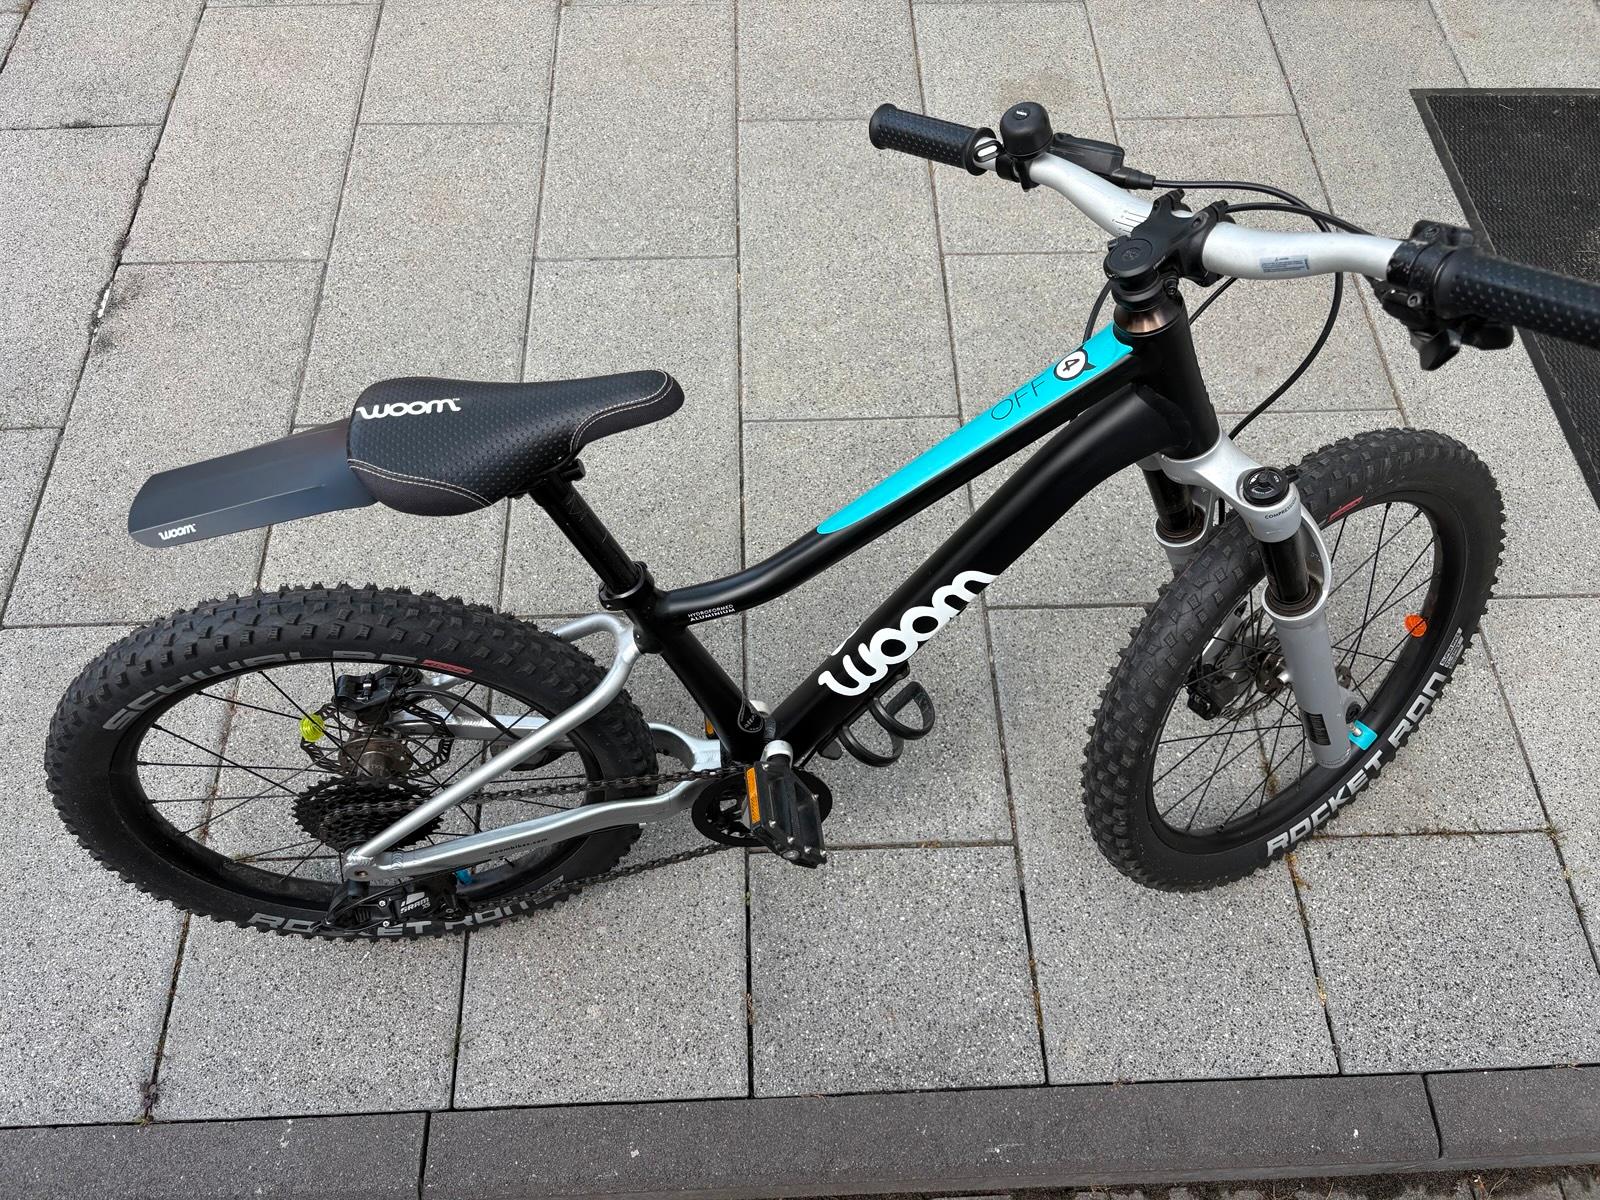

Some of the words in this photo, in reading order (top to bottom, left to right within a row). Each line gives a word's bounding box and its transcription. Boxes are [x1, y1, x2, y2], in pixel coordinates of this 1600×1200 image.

[991, 373, 1046, 420] OFF
[1062, 358, 1080, 372] 4
[356, 398, 461, 420] woom
[158, 523, 197, 541] woom
[690, 608, 736, 622] ALUMINIUM
[817, 570, 1000, 697] woom
[1266, 749, 1384, 857] ROCKET
[1387, 671, 1448, 749] RON
[249, 912, 432, 937] ROET
